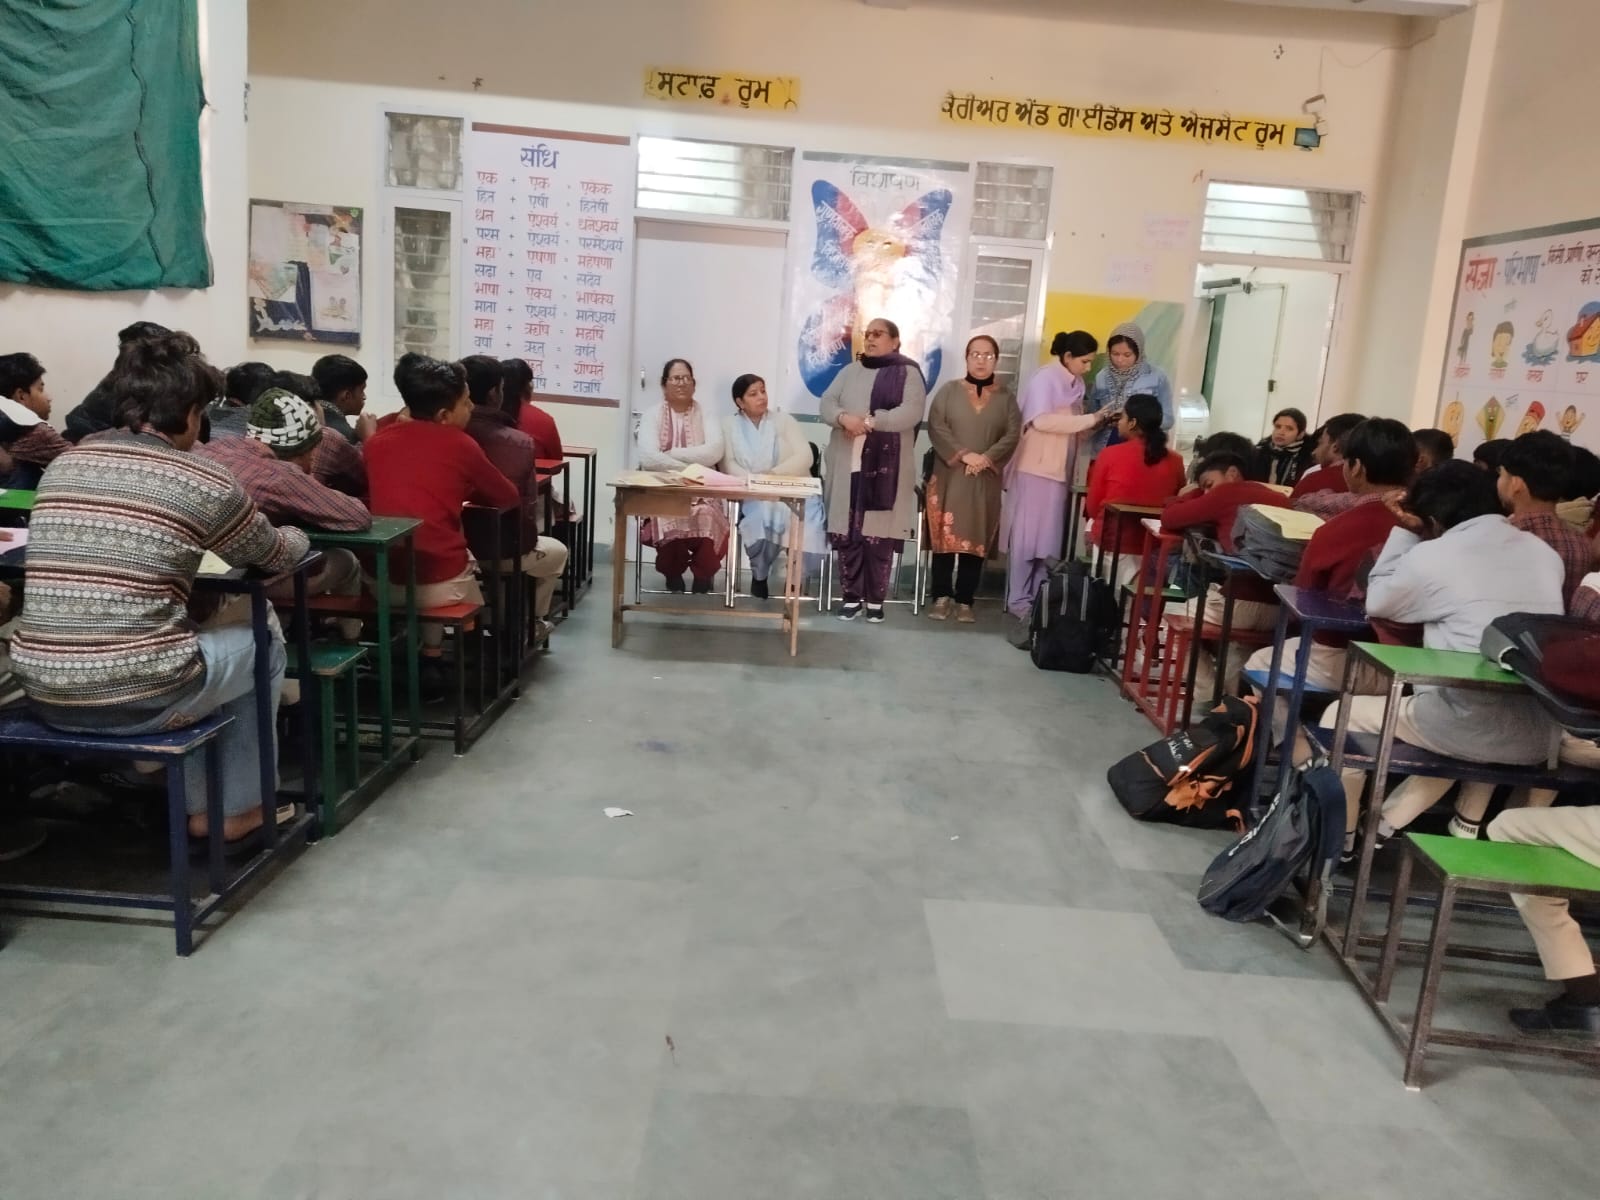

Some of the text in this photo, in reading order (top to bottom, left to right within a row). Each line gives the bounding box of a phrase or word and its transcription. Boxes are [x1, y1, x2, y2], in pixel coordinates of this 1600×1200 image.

[734, 77, 773, 108] ਰੂਮ
[1140, 108, 1175, 136] ਅਤੇ
[1254, 121, 1288, 150] ਰੂਮ
[520, 143, 559, 169] संधि
[476, 171, 498, 185] एक
[528, 176, 550, 191] एक
[475, 208, 495, 222] धन
[475, 226, 500, 241] परम
[475, 246, 496, 259] महा
[526, 268, 543, 283] एव
[474, 300, 497, 314] माता
[474, 317, 495, 331] महा
[533, 375, 547, 390] षि
